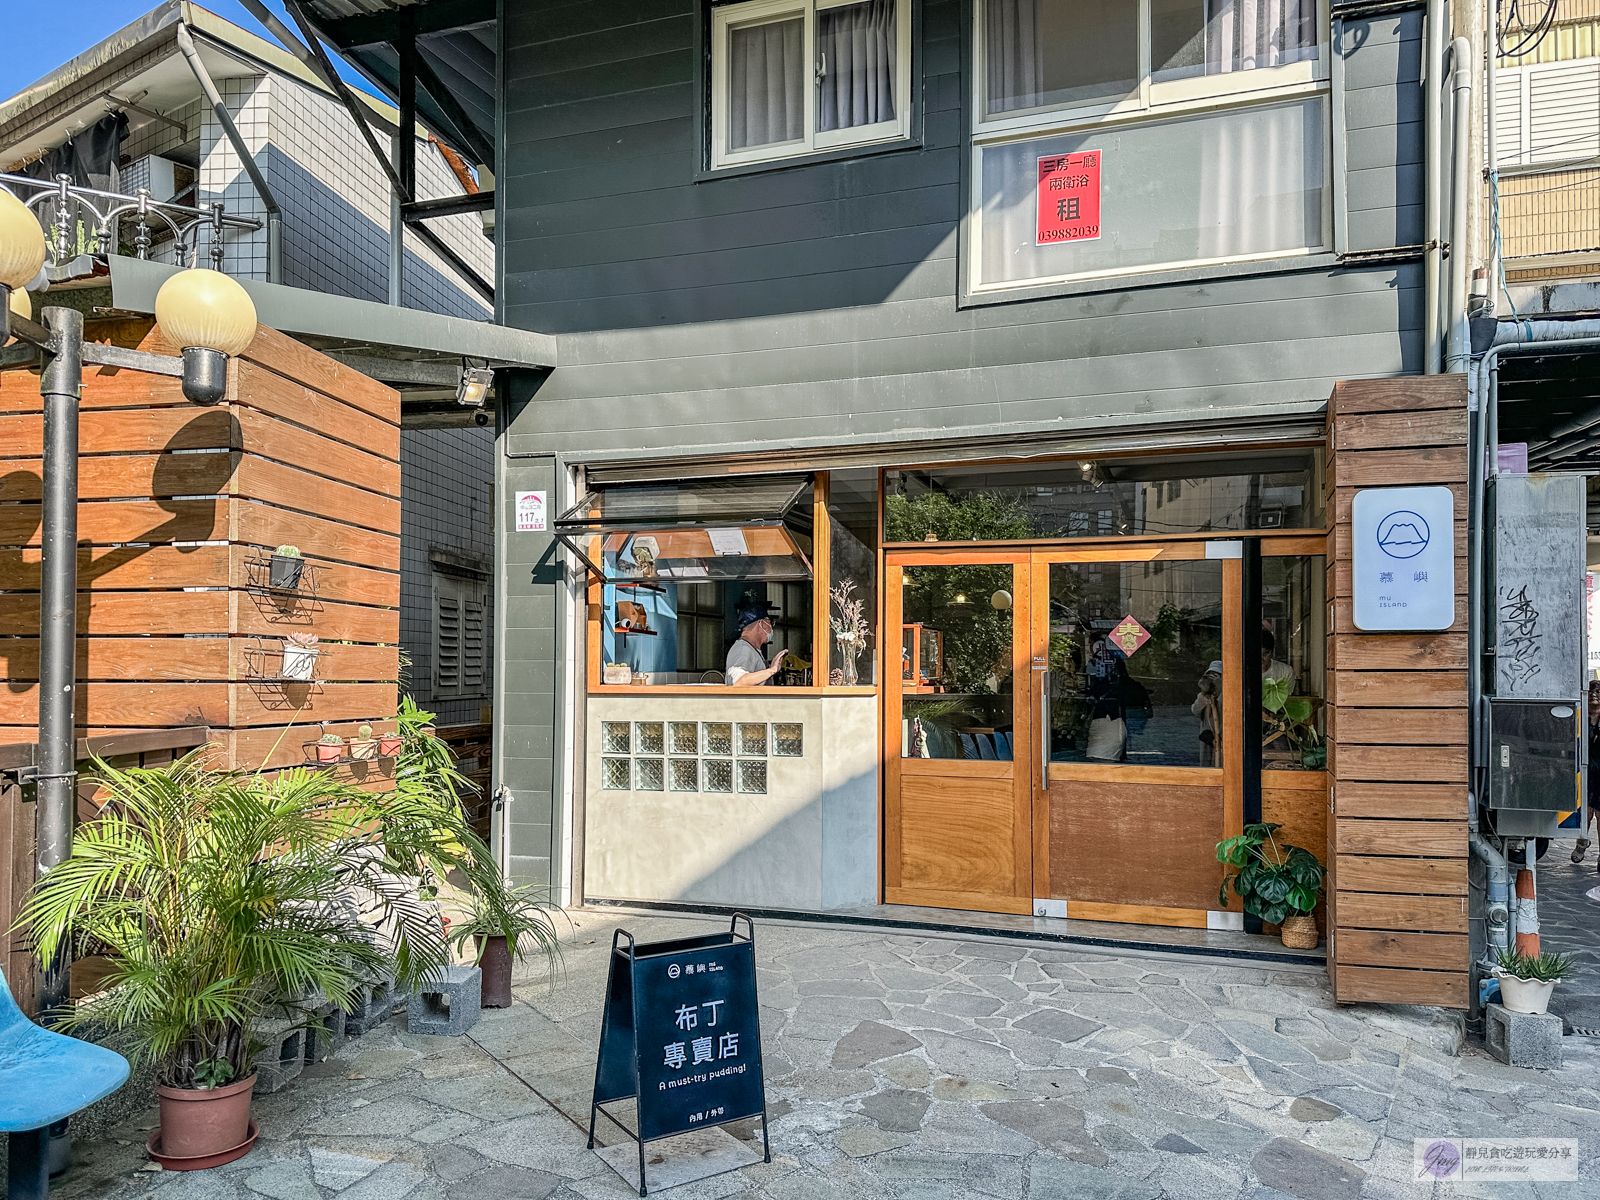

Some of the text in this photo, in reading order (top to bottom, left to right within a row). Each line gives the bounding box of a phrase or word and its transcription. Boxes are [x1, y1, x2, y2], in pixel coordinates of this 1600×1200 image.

[1043, 155, 1097, 173] 三房一廳
[1049, 174, 1090, 191] 兩衛浴
[1057, 197, 1081, 222] 租
[1038, 225, 1099, 241] 039882039
[675, 999, 725, 1031] 布丁
[663, 1031, 739, 1069] 專賣店
[659, 1063, 747, 1091] A must-try pudding!
[710, 1106, 725, 1117] 外帶
